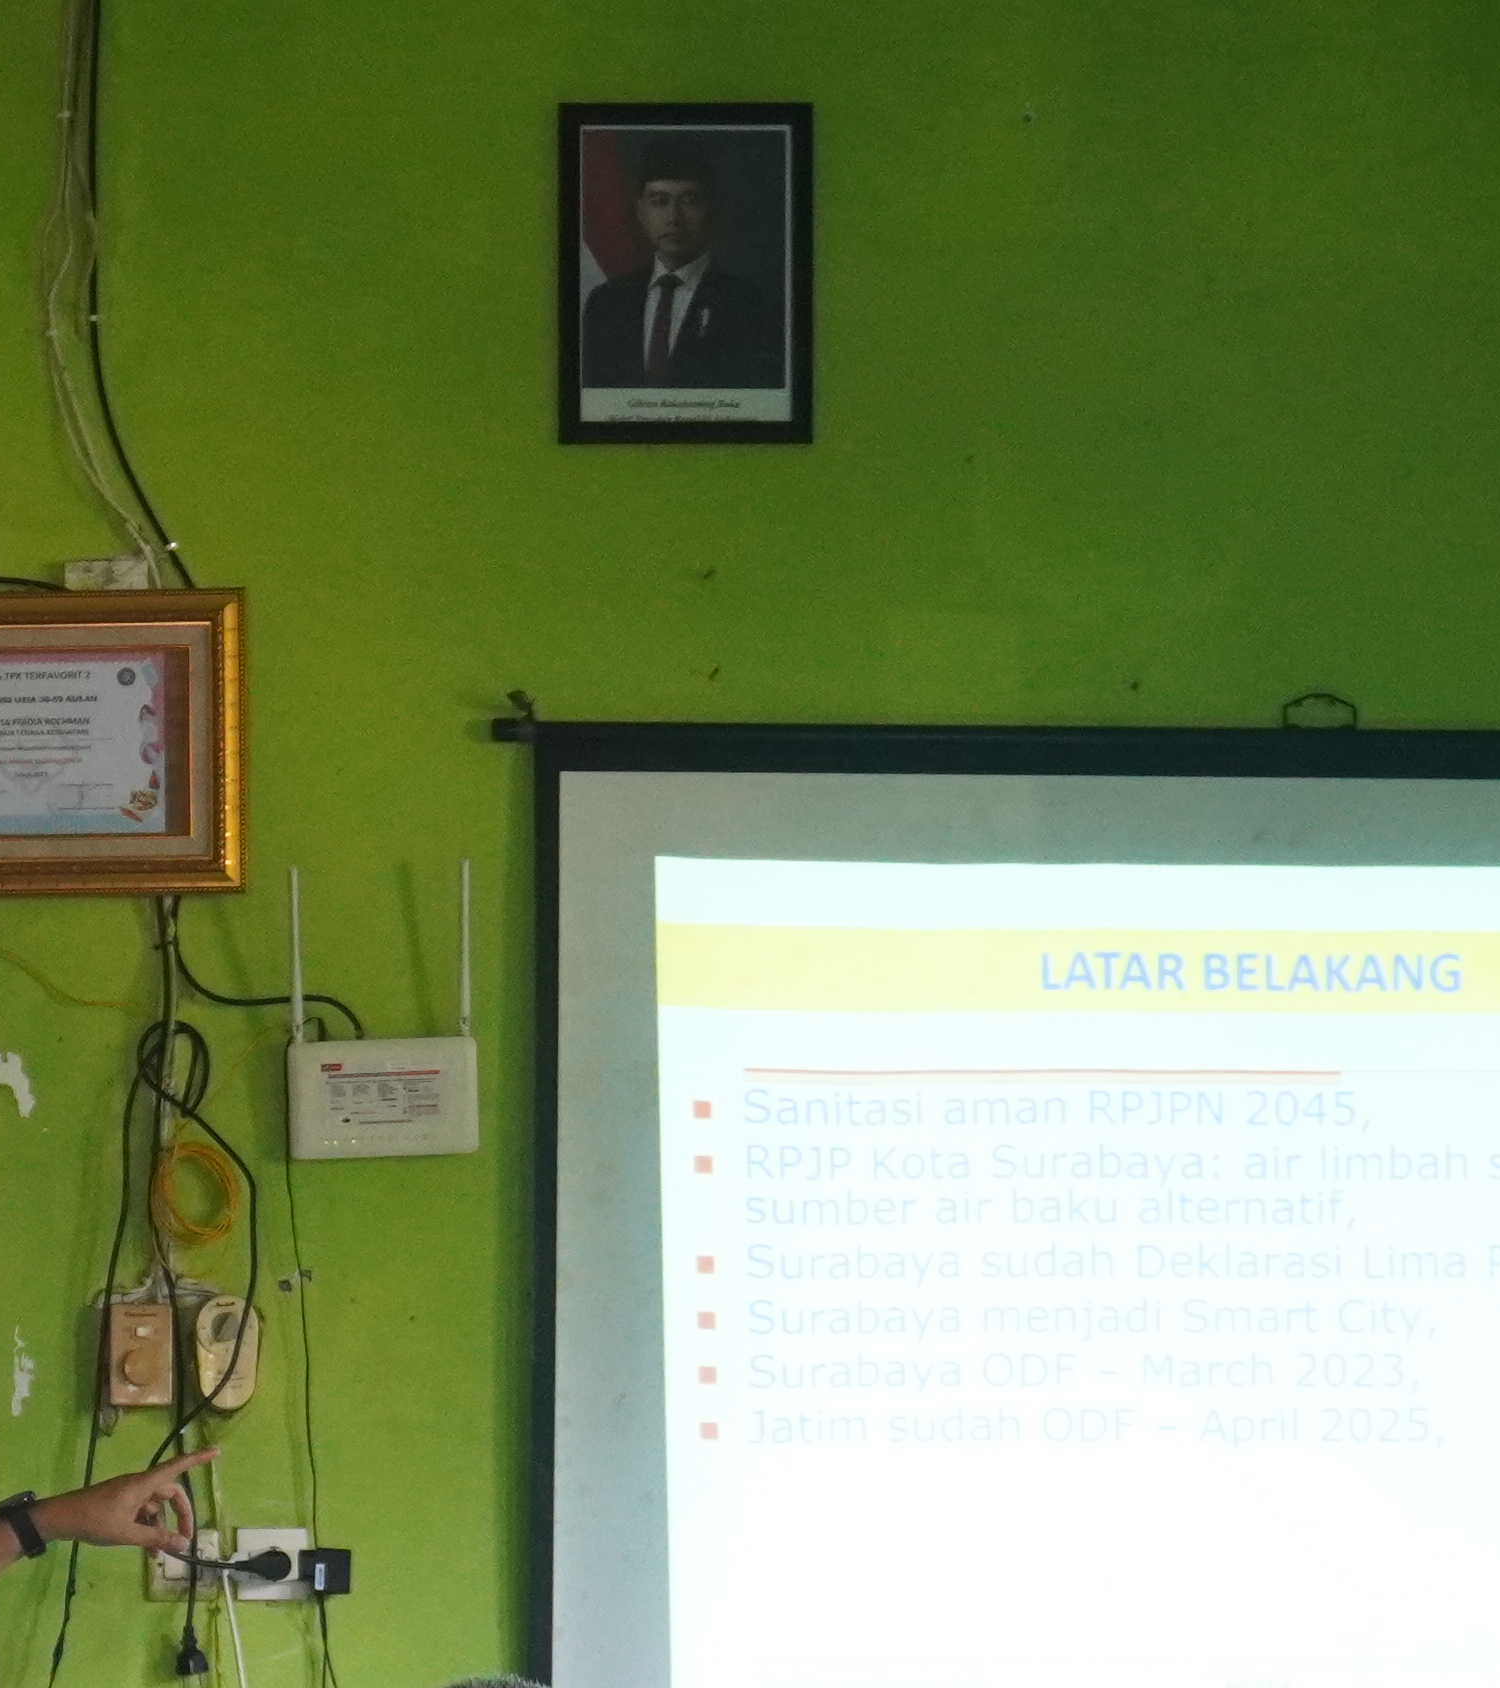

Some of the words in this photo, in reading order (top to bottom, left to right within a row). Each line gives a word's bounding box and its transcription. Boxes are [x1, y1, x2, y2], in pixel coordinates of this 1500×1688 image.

[1039, 951, 1187, 992] LATAR
[1201, 952, 1464, 994] BELAKANG
[742, 1087, 924, 1128] Sanitasi
[942, 1095, 1068, 1127] aman
[1087, 1089, 1225, 1127] RPJPN
[1245, 1089, 1371, 1134] 2045,
[744, 1144, 853, 1183] RPJP
[871, 1146, 971, 1182] Kota
[990, 1143, 1221, 1190] Surabaya:
[1243, 1144, 1303, 1181] air
[1319, 1143, 1468, 1181] limbah
[744, 1189, 918, 1227] sumber
[934, 1190, 994, 1226] air
[1010, 1188, 1119, 1226] baku
[1138, 1188, 1357, 1231] alternatif,
[745, 1243, 962, 1288] Surabaya
[981, 1243, 1114, 1280] sudah
[1135, 1243, 1343, 1280] Deklarasi
[1363, 1243, 1468, 1280] Lima
[746, 1299, 962, 1344] Surabaya
[982, 1298, 1164, 1344] menjadi
[1181, 1298, 1320, 1336] Smart
[1337, 1297, 1438, 1345] City,
[748, 1353, 962, 1398] Surabaya
[981, 1352, 1078, 1390] ODF
[1142, 1352, 1275, 1389] March
[1294, 1352, 1422, 1395] 2023,
[748, 1408, 869, 1445] Jatim
[887, 1407, 1022, 1445] sudah
[1041, 1407, 1137, 1444] ODF
[1199, 1407, 1301, 1454] April
[1319, 1407, 1446, 1450] 2025,
